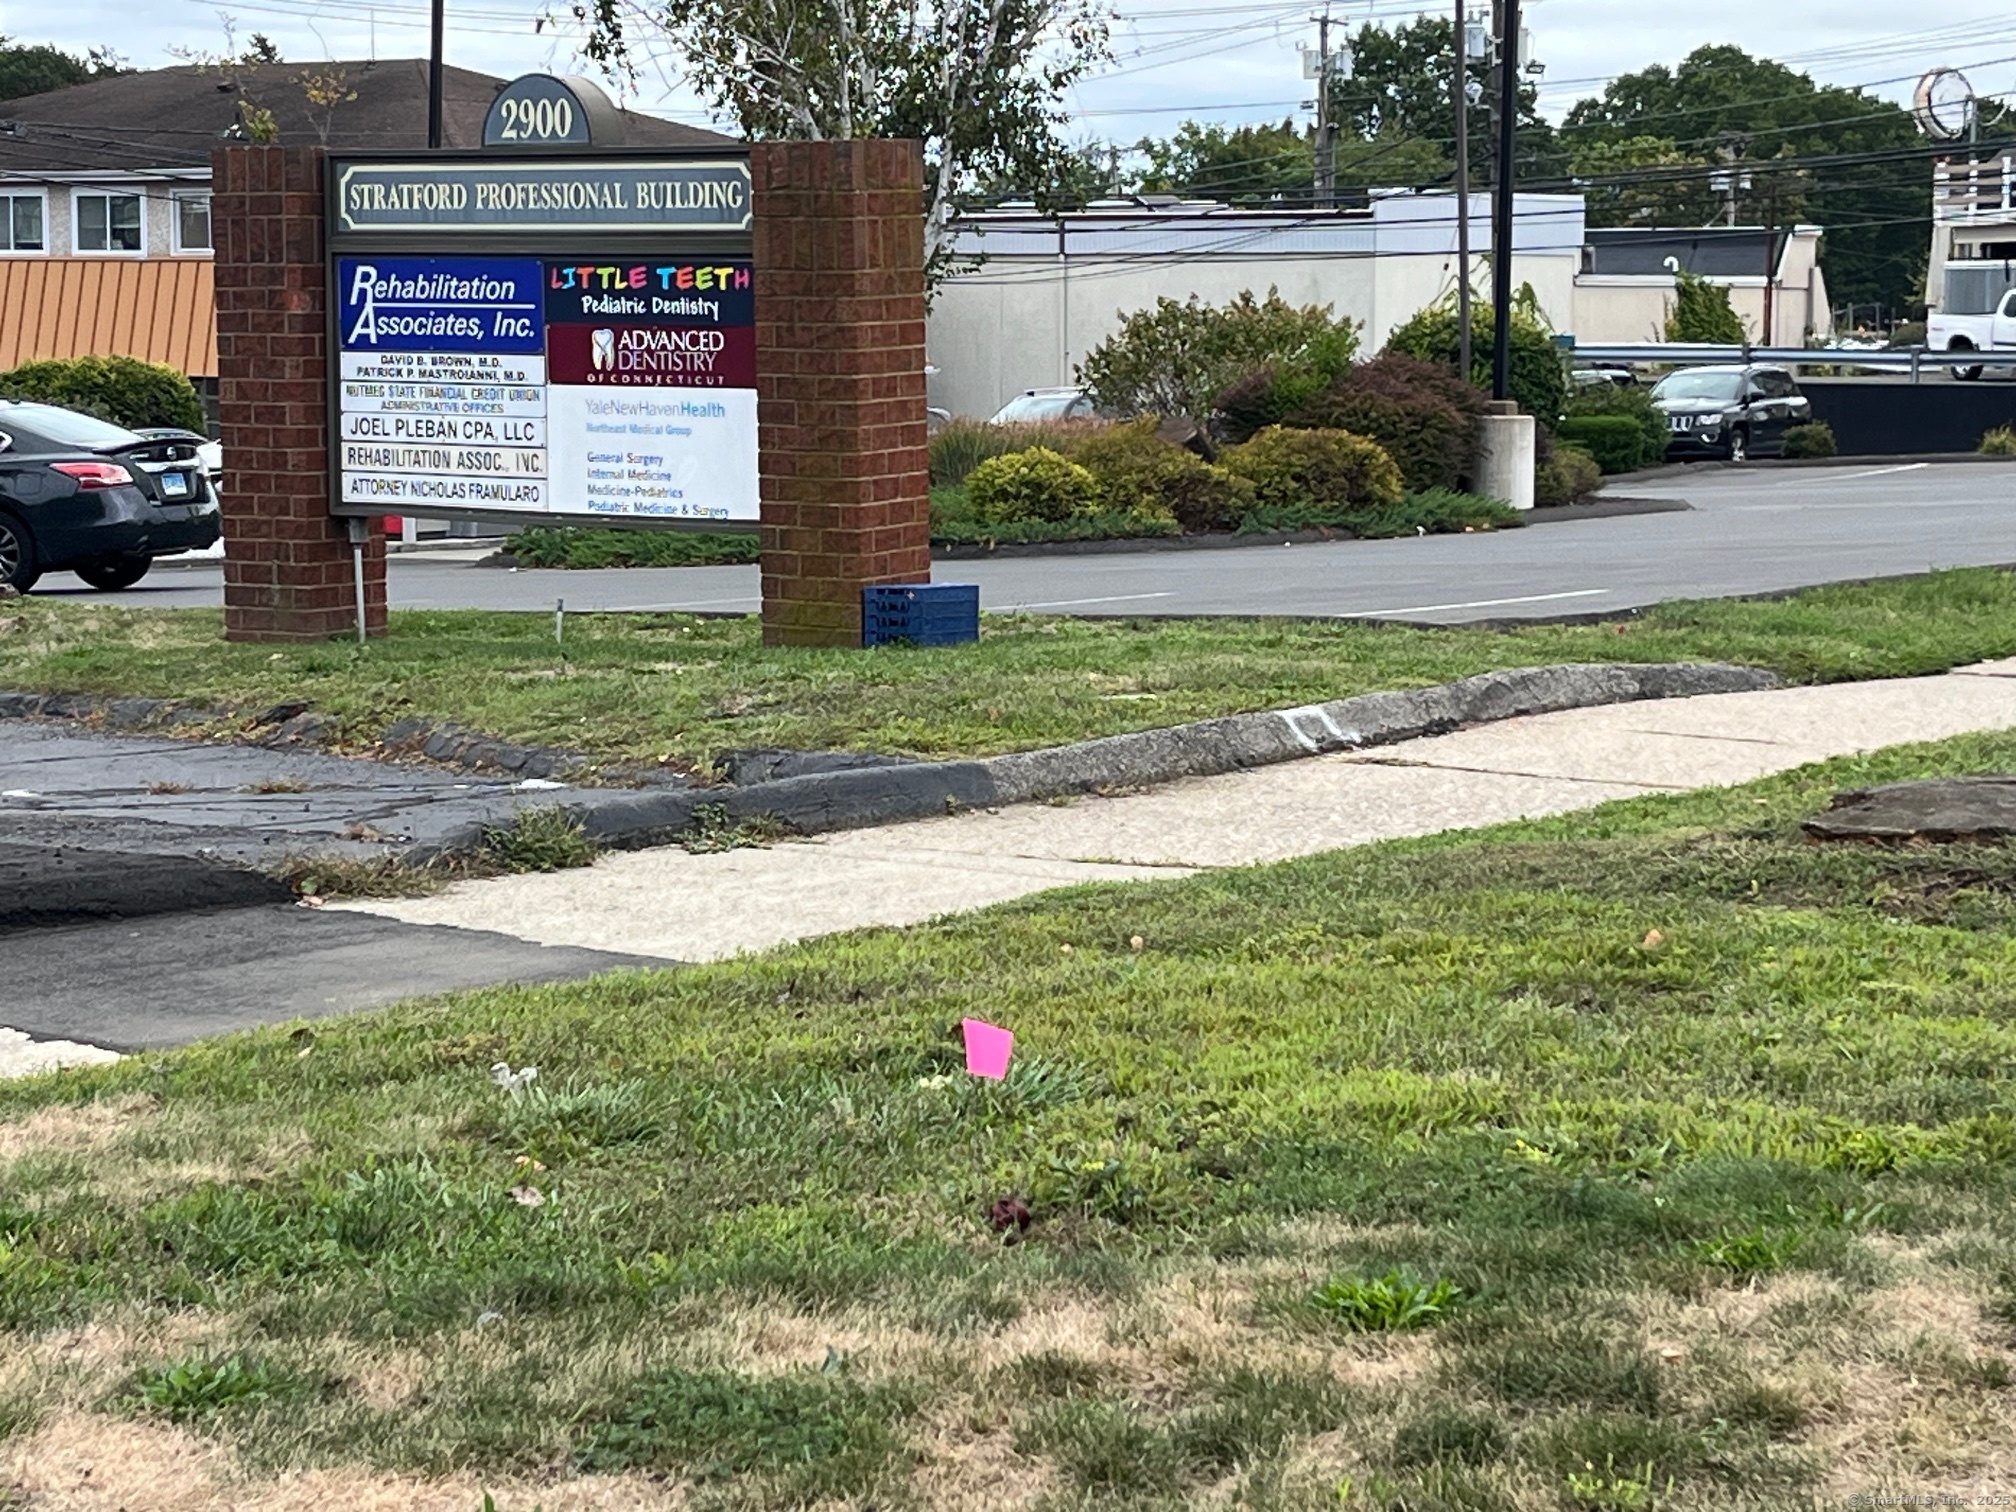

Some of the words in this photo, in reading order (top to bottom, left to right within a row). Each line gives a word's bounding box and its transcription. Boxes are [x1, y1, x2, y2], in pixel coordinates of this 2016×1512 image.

[501, 98, 573, 140] 2900
[350, 183, 467, 211] STRATFORD
[475, 182, 628, 210] PROFESSIONAL
[636, 180, 743, 209] BUILDING
[350, 265, 515, 305] Rehabilitation
[551, 266, 648, 289] LITTLE
[656, 266, 750, 291] TEETH
[581, 294, 648, 314] Pediatric
[652, 296, 719, 321] Dentistry
[348, 305, 485, 344] Associates,
[493, 311, 535, 337] Inc.
[618, 330, 725, 351] ADVANCED
[381, 355, 413, 366] DAVID
[417, 356, 427, 366] B.
[431, 356, 475, 368] BROWN,
[479, 358, 502, 368] M.D.
[618, 350, 718, 372] DENTISTRY
[357, 366, 403, 378] PATRICK
[407, 367, 416, 378] P.
[418, 368, 500, 382] MASTROIANNI,
[504, 371, 528, 381] M.D.
[587, 373, 604, 384] OF
[610, 374, 724, 385] CONNECTICUT
[346, 385, 385, 397] NUTMEG
[388, 385, 416, 398] STATE
[420, 386, 468, 400] FINANCIAL
[472, 387, 505, 401] CREDIT
[509, 389, 540, 401] UNION
[381, 401, 459, 412] ADMINISTRATIVE
[462, 402, 504, 413] OFFICES
[585, 399, 725, 418] YaleNewHavenHealth
[351, 417, 390, 436] JOEL
[395, 418, 457, 439] PLEBAN
[463, 420, 498, 443] CPA,
[504, 422, 535, 441] LLC
[586, 422, 627, 434] Northeast
[629, 423, 663, 435] Medical
[665, 425, 692, 438] Group
[348, 447, 451, 470] REHABILITATION
[515, 452, 543, 473] INC.
[587, 451, 623, 464] General
[627, 452, 663, 467] Surgery
[587, 468, 624, 480] Internal
[627, 469, 672, 482] Medicine
[351, 478, 408, 496] ATTORNEY
[411, 480, 466, 499] NICHOLAS
[469, 481, 540, 502] FRAMULARO
[587, 484, 683, 499] Medicine-Pediatrics
[634, 501, 678, 515] Medicine
[681, 504, 689, 516] &
[693, 505, 729, 520] Surgery
